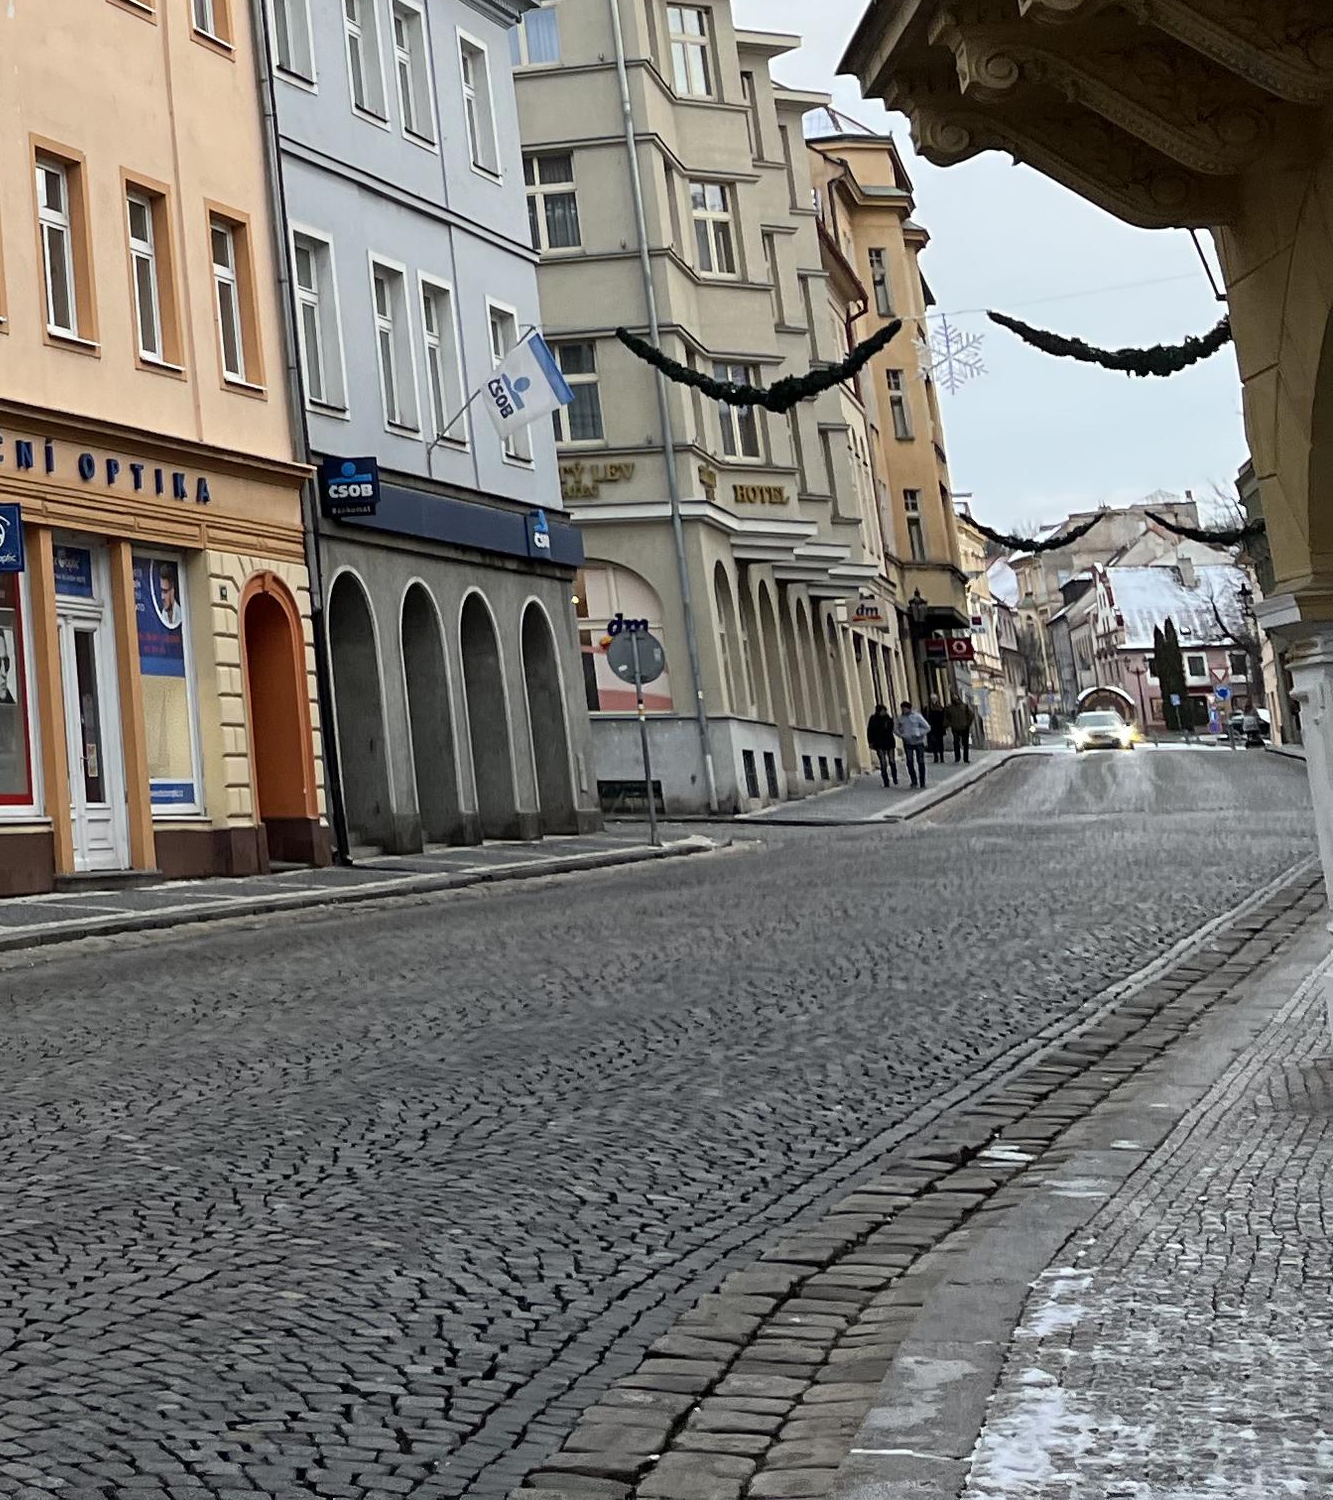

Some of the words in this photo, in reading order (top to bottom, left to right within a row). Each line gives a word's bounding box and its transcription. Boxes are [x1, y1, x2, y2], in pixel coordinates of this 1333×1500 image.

[78, 452, 211, 504] OPTIKA
[732, 484, 790, 505] HOTEL
[856, 604, 878, 616] dm
[607, 613, 649, 636] dm
